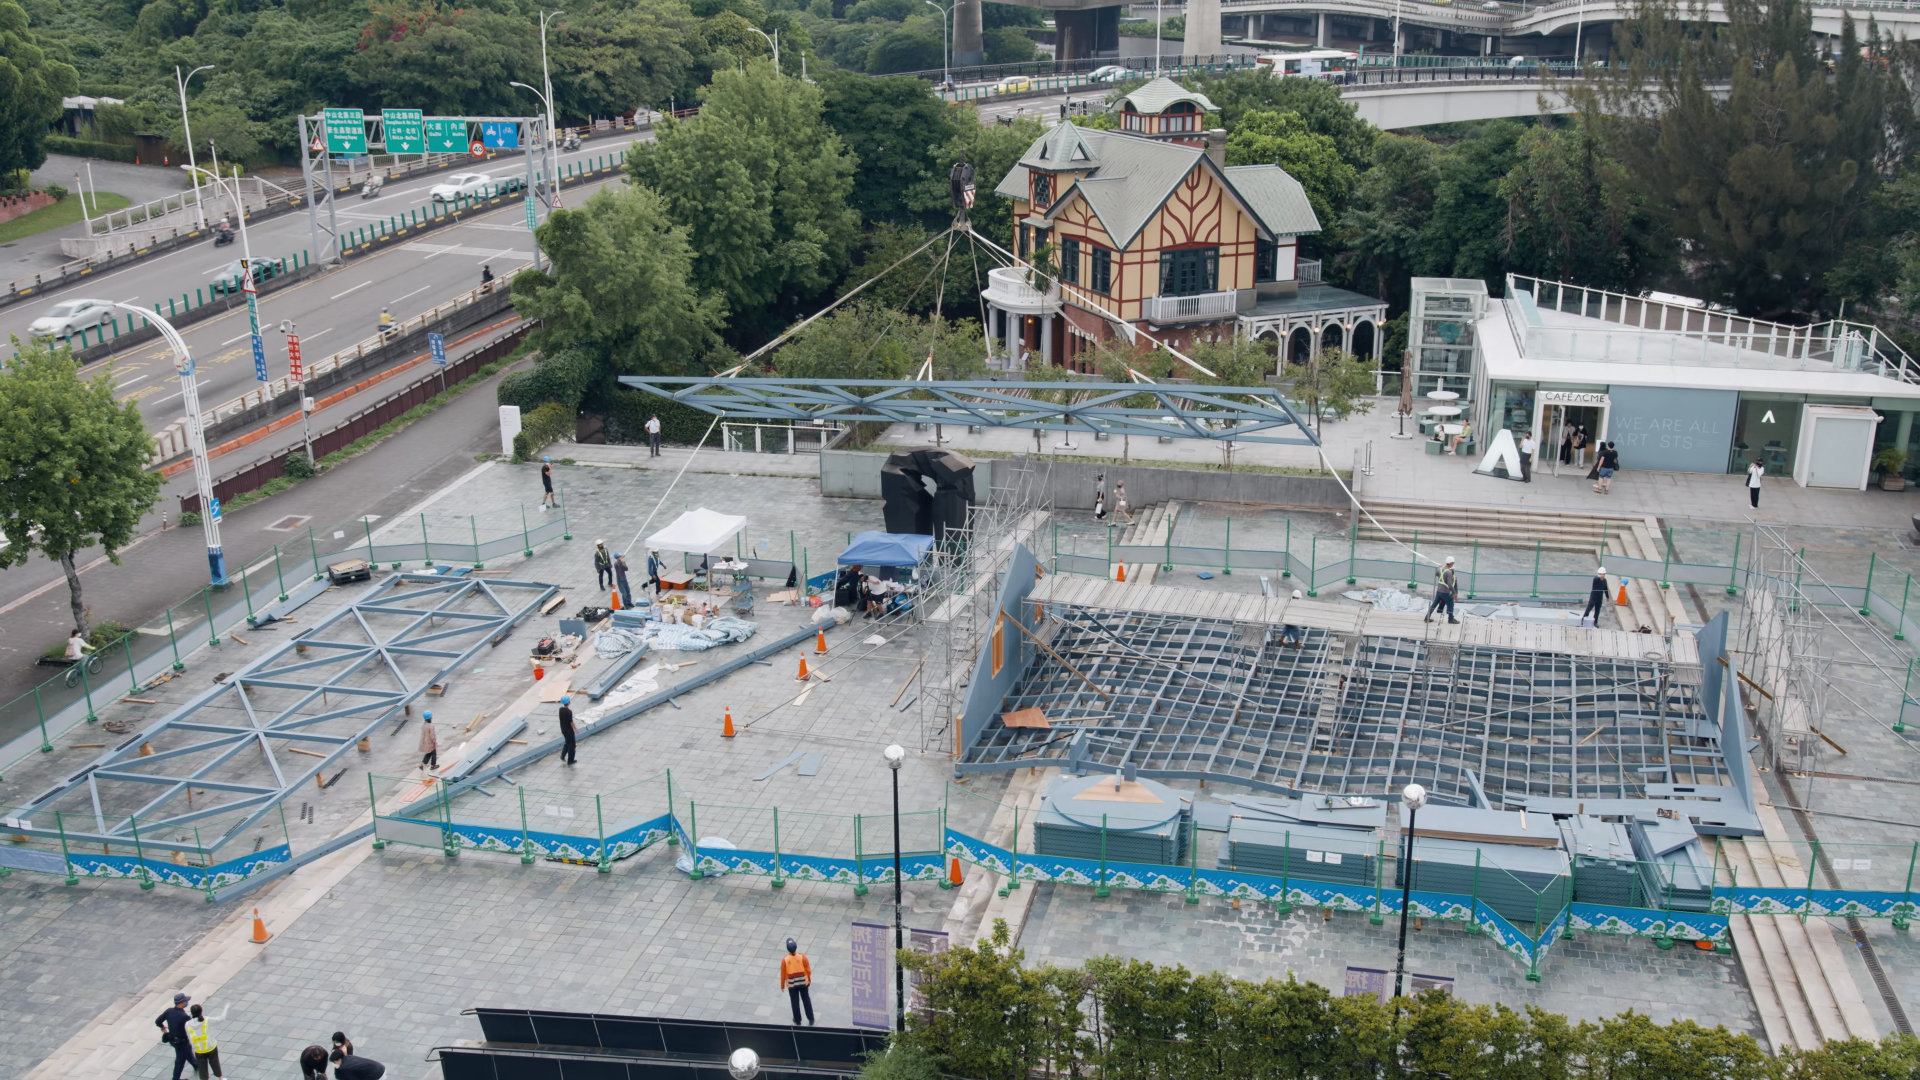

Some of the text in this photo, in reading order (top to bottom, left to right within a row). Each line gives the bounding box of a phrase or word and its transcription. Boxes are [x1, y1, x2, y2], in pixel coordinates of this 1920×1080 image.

[326, 111, 362, 119] 中山北路三段
[1546, 392, 1573, 401] CAFÉ
[1616, 416, 1720, 434] WE ARE ALL
